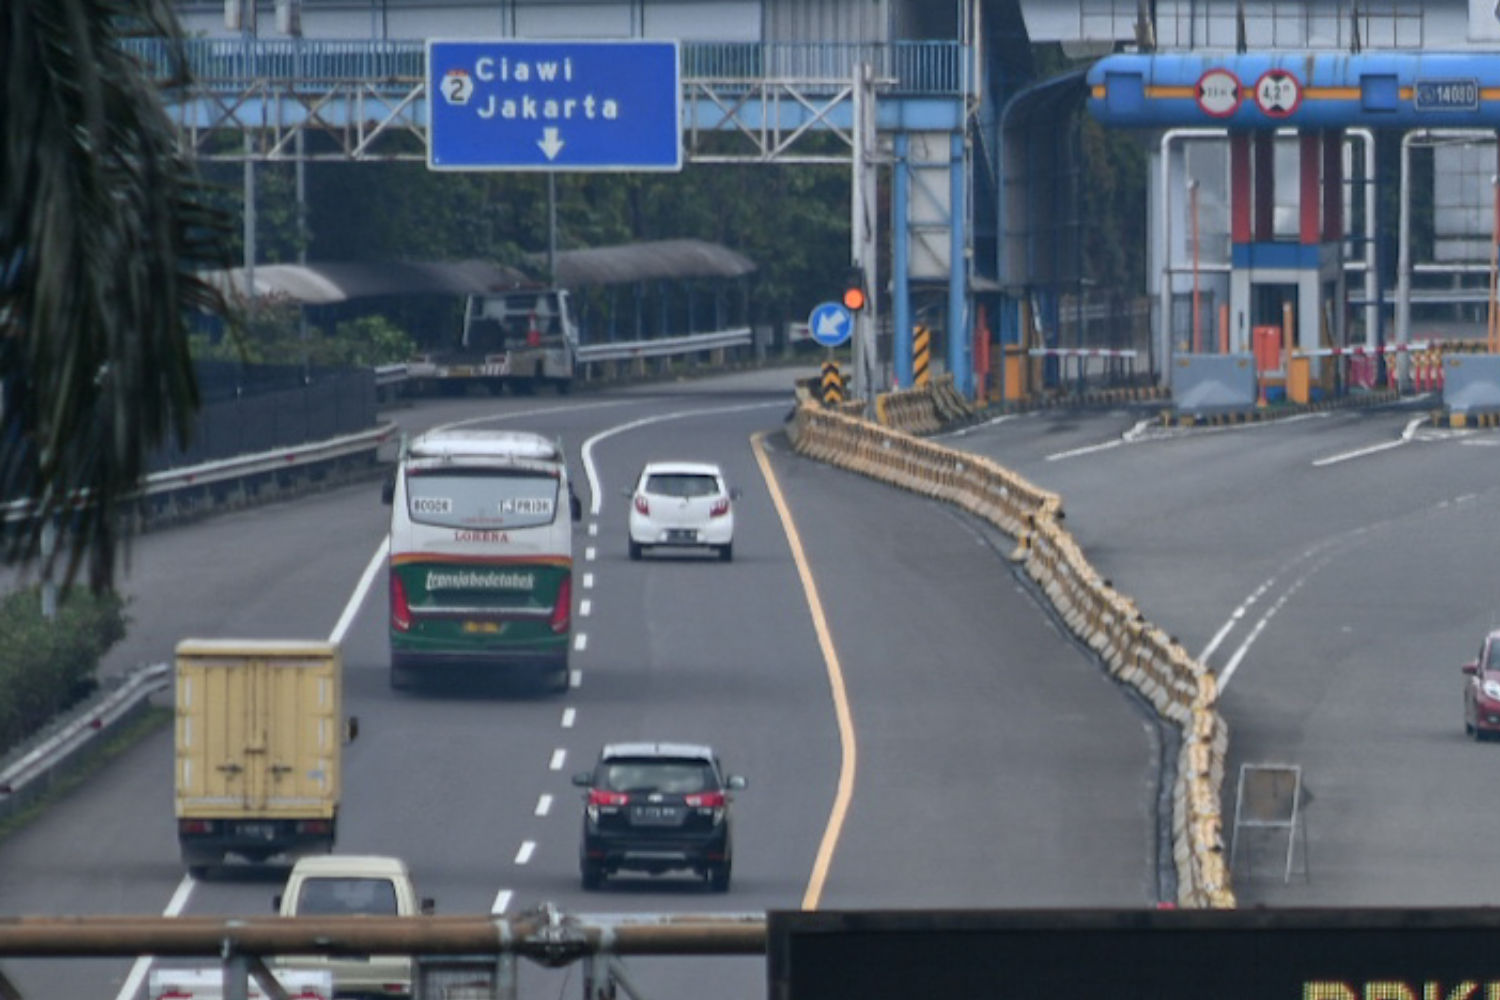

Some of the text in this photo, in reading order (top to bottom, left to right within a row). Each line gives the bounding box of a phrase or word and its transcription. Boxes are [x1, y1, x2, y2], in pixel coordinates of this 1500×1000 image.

[475, 57, 572, 82] Ciawi
[450, 78, 465, 101] 2
[477, 95, 617, 119] Jakarta
[454, 531, 509, 544] LORENA
